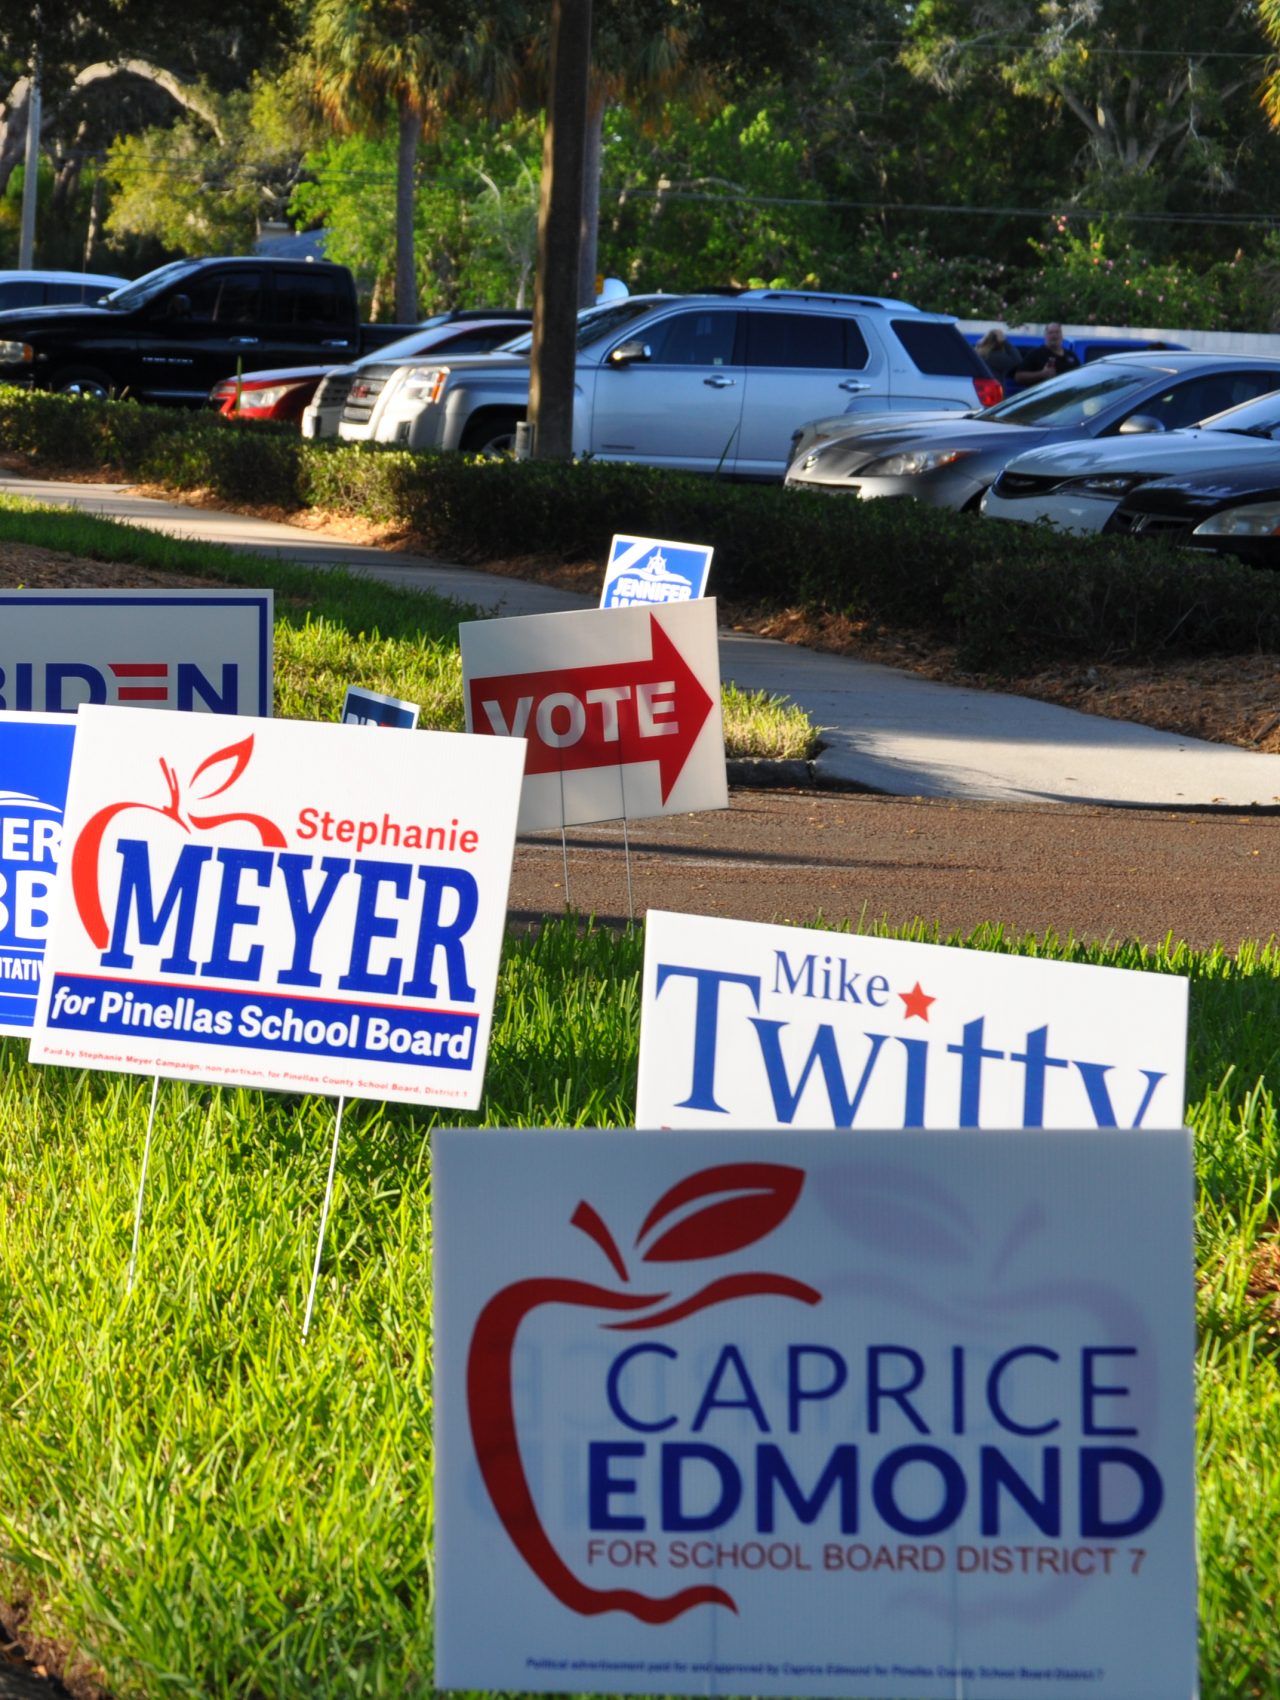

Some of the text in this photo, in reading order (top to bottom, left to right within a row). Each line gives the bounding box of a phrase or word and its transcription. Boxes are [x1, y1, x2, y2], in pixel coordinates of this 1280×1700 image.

[612, 576, 692, 602] JENNIFER
[481, 681, 679, 748] VOTE
[295, 807, 480, 853] Stephanie
[100, 838, 479, 1003] MEYER
[771, 949, 890, 1009] Mike
[51, 986, 473, 1060] for Pinellas School Board
[43, 1047, 64, 1056] Paid
[65, 1047, 76, 1057] by
[78, 1050, 122, 1062] Stephanie
[125, 1055, 153, 1066] Meyer
[268, 1070, 281, 1079] for
[283, 1072, 320, 1083] Pinellas
[322, 1076, 355, 1087] County
[358, 1080, 389, 1089] School
[424, 1086, 460, 1097] District
[605, 1341, 1139, 1438] CAPRICE
[587, 1441, 1165, 1539] EDMOND
[586, 1538, 1147, 1575] FOR SCHOOL BOARD DISTRICT 7
